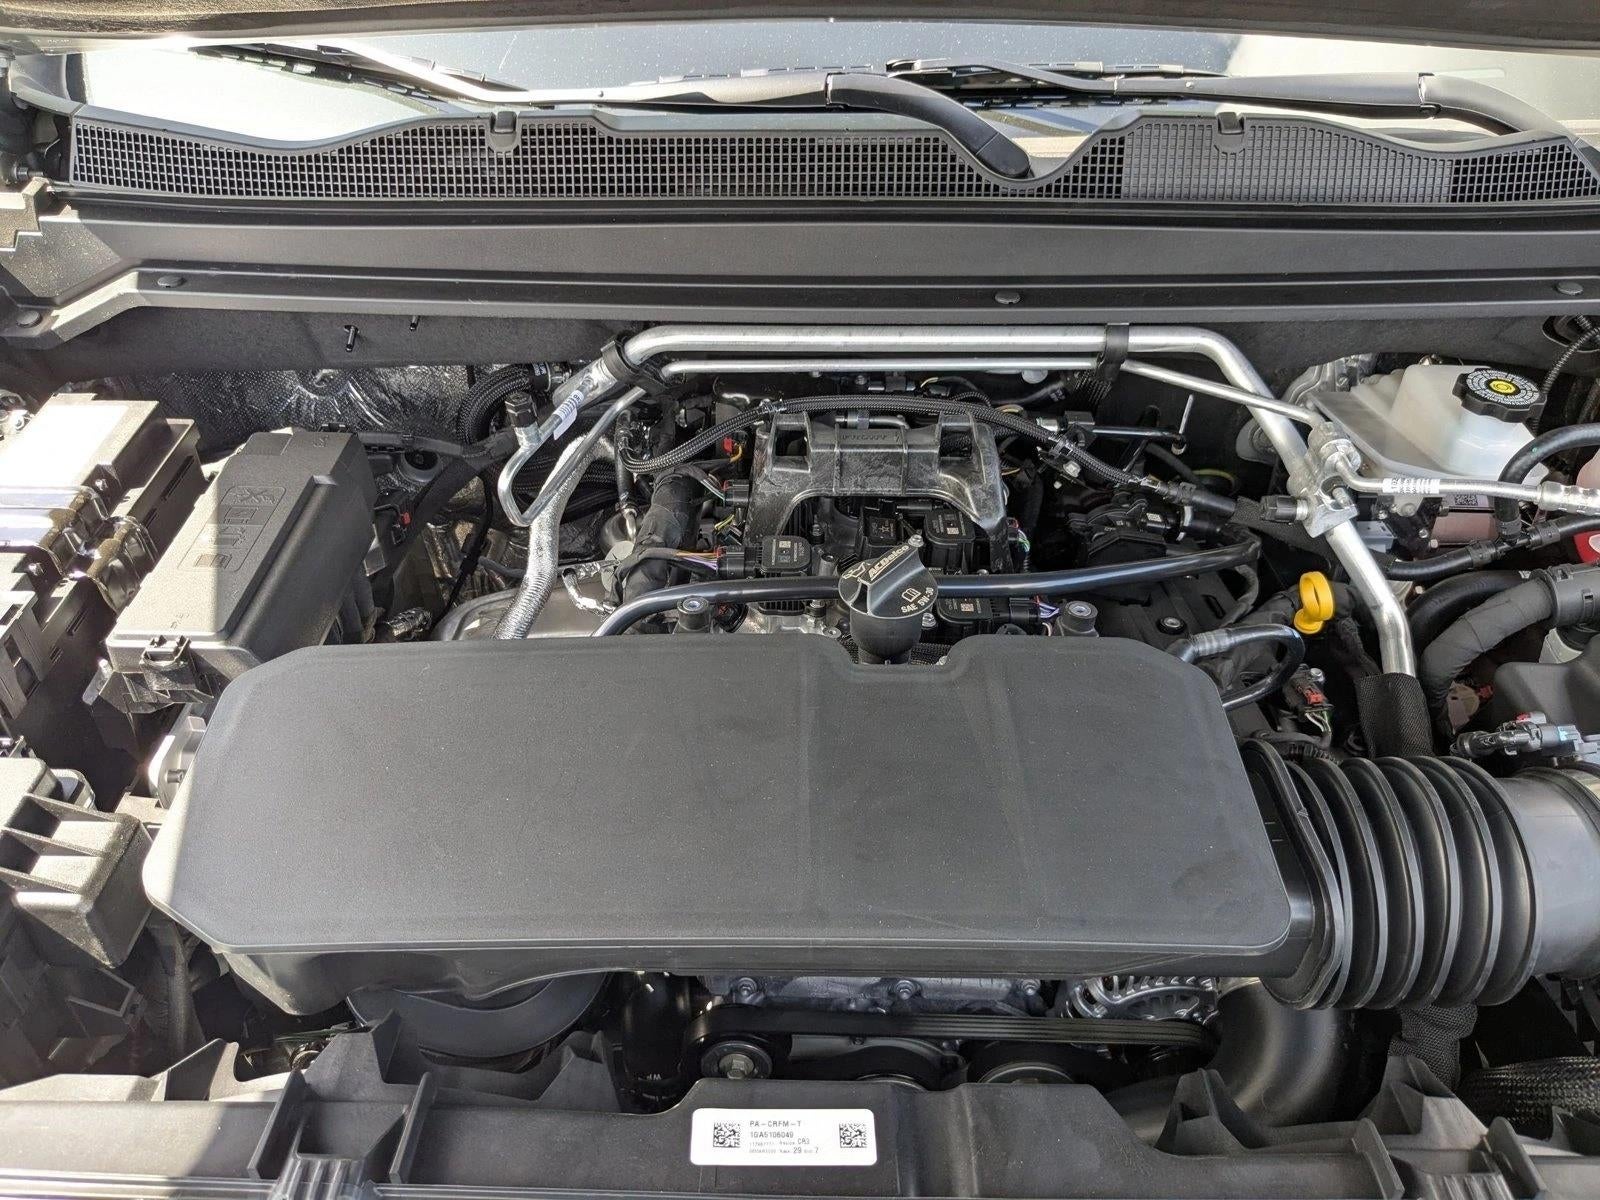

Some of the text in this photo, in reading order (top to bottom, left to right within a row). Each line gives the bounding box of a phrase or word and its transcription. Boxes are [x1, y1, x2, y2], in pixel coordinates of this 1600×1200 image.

[868, 545, 910, 579] ACDelco
[900, 587, 934, 613] SAE 5W-30
